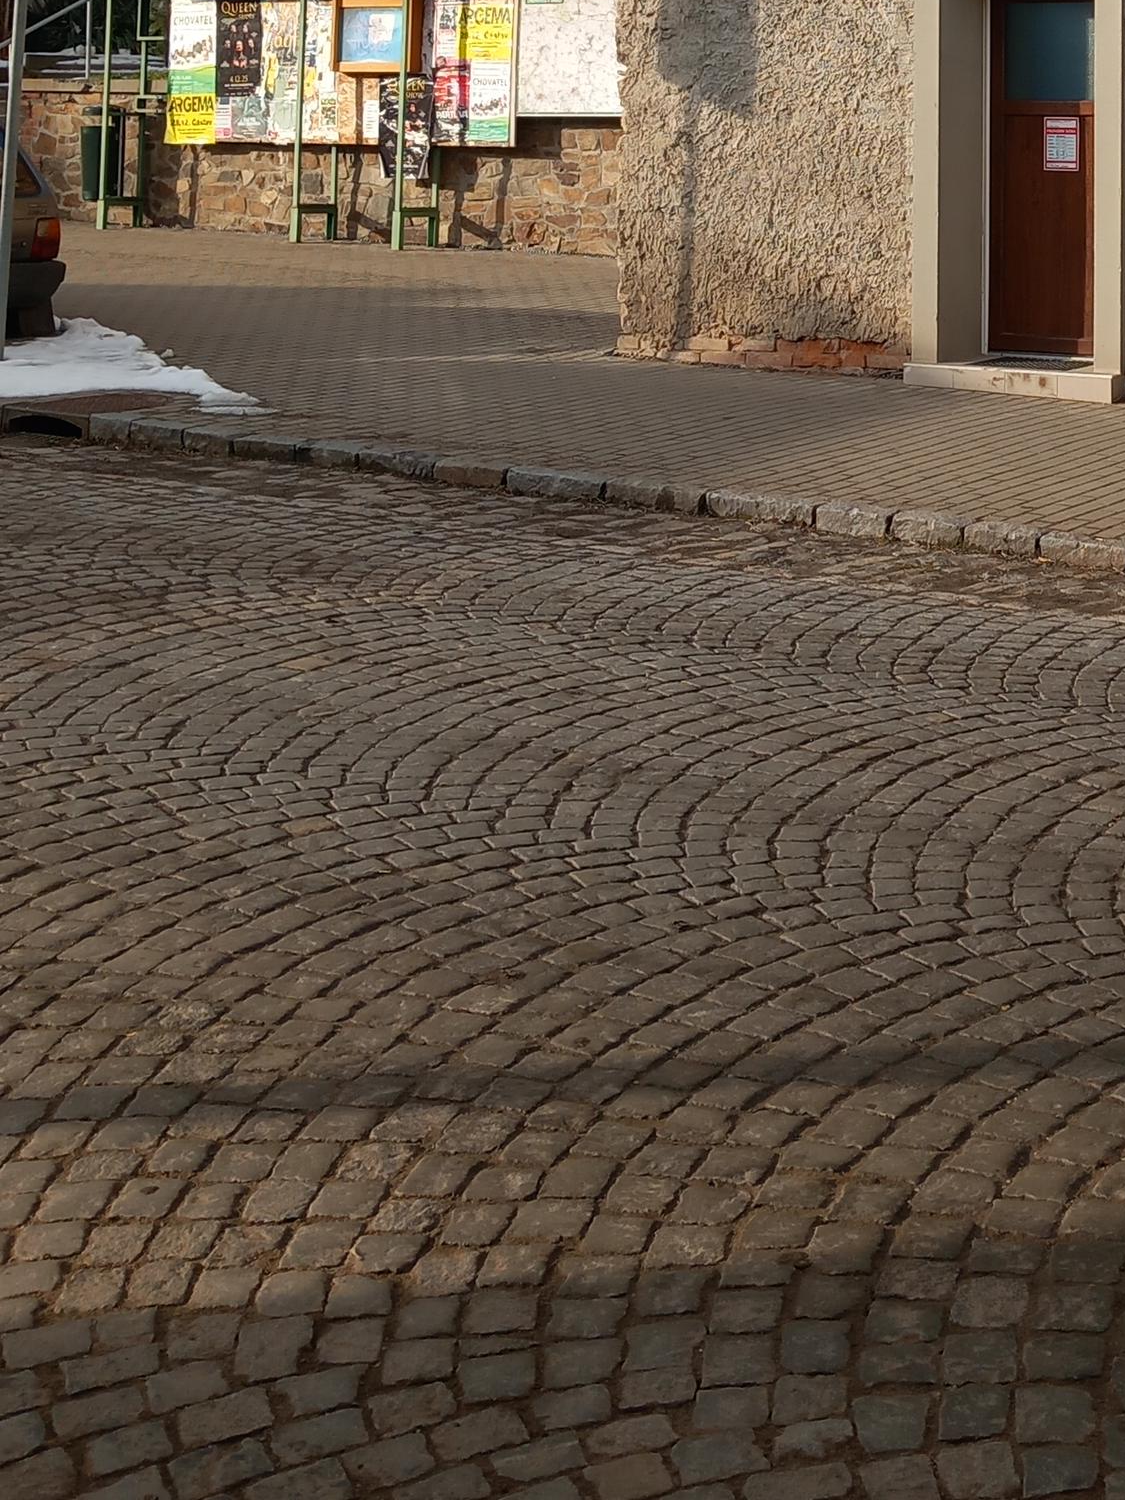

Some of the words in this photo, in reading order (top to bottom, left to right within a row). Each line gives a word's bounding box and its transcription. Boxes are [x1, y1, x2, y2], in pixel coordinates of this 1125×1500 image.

[221, 1, 258, 16] QUEEN
[458, 6, 511, 25] ARGEMA
[173, 14, 214, 26] CHOVATEL
[472, 77, 508, 87] CHOVATEL
[168, 95, 215, 113] ARGEMA
